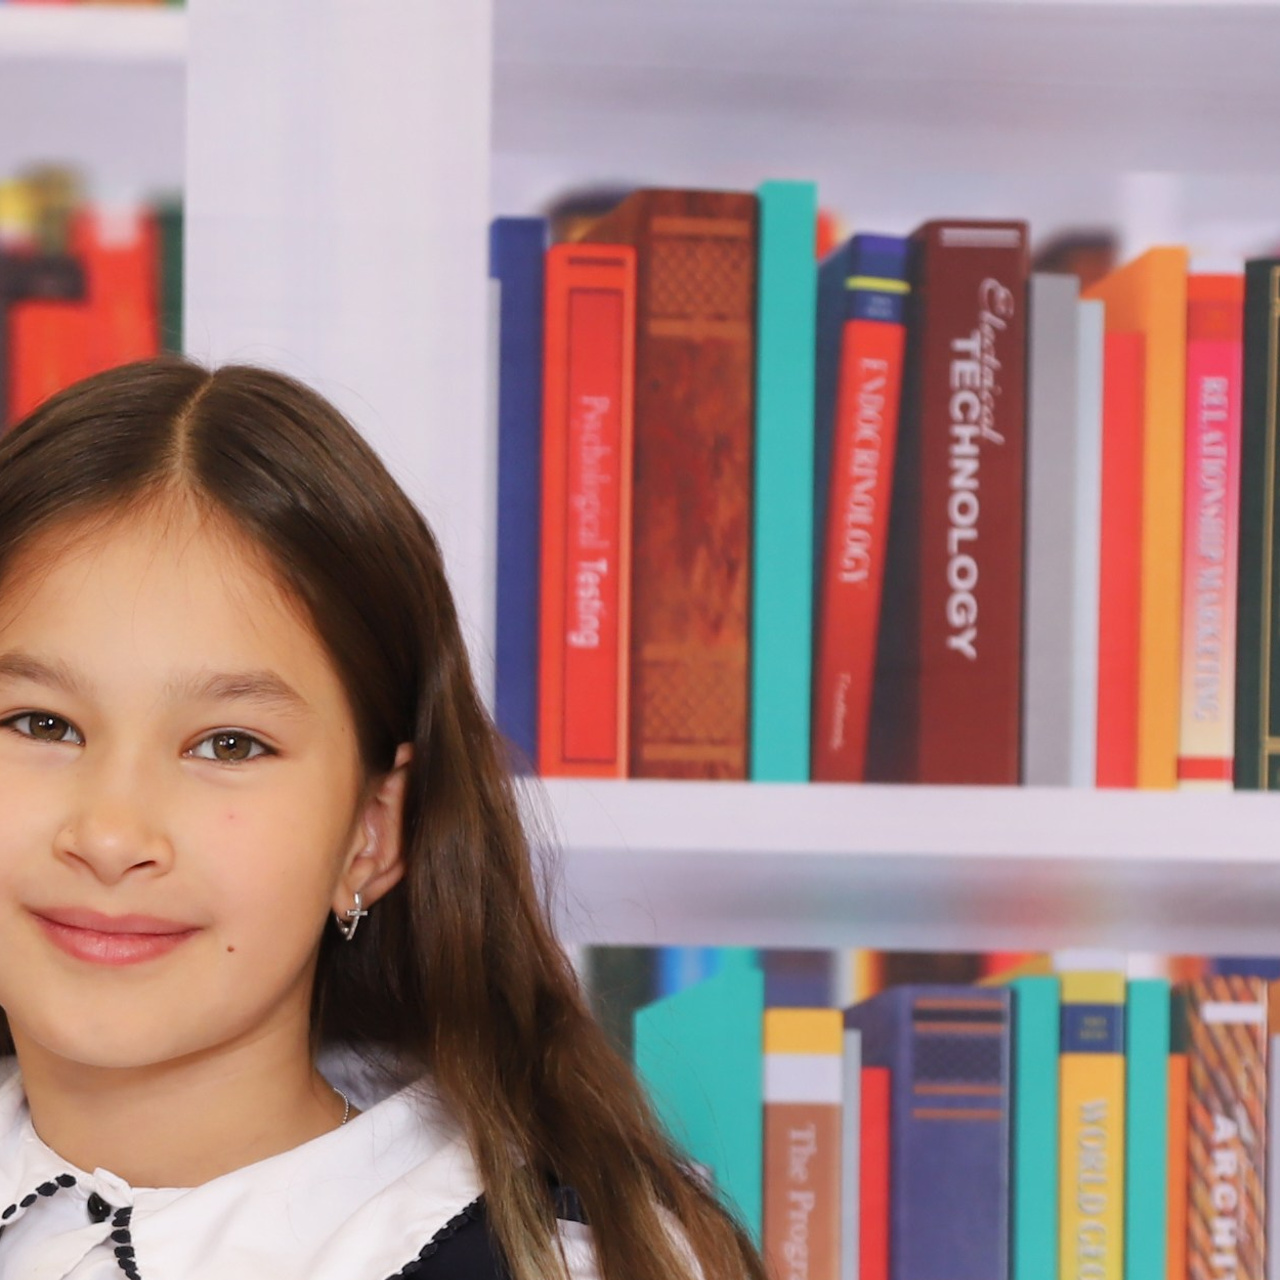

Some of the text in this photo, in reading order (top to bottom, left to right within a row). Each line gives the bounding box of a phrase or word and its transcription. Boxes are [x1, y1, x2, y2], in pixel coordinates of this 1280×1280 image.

[836, 356, 890, 586] ENDOCRINOLOGY
[979, 278, 1014, 444] Electrical
[567, 395, 611, 649] Psychological Testing
[947, 330, 982, 660] TECHNOLOGY
[1191, 376, 1229, 722] RELATIONSHIP MARKETING
[786, 1123, 818, 1183] The
[1075, 1098, 1110, 1213] WORLD
